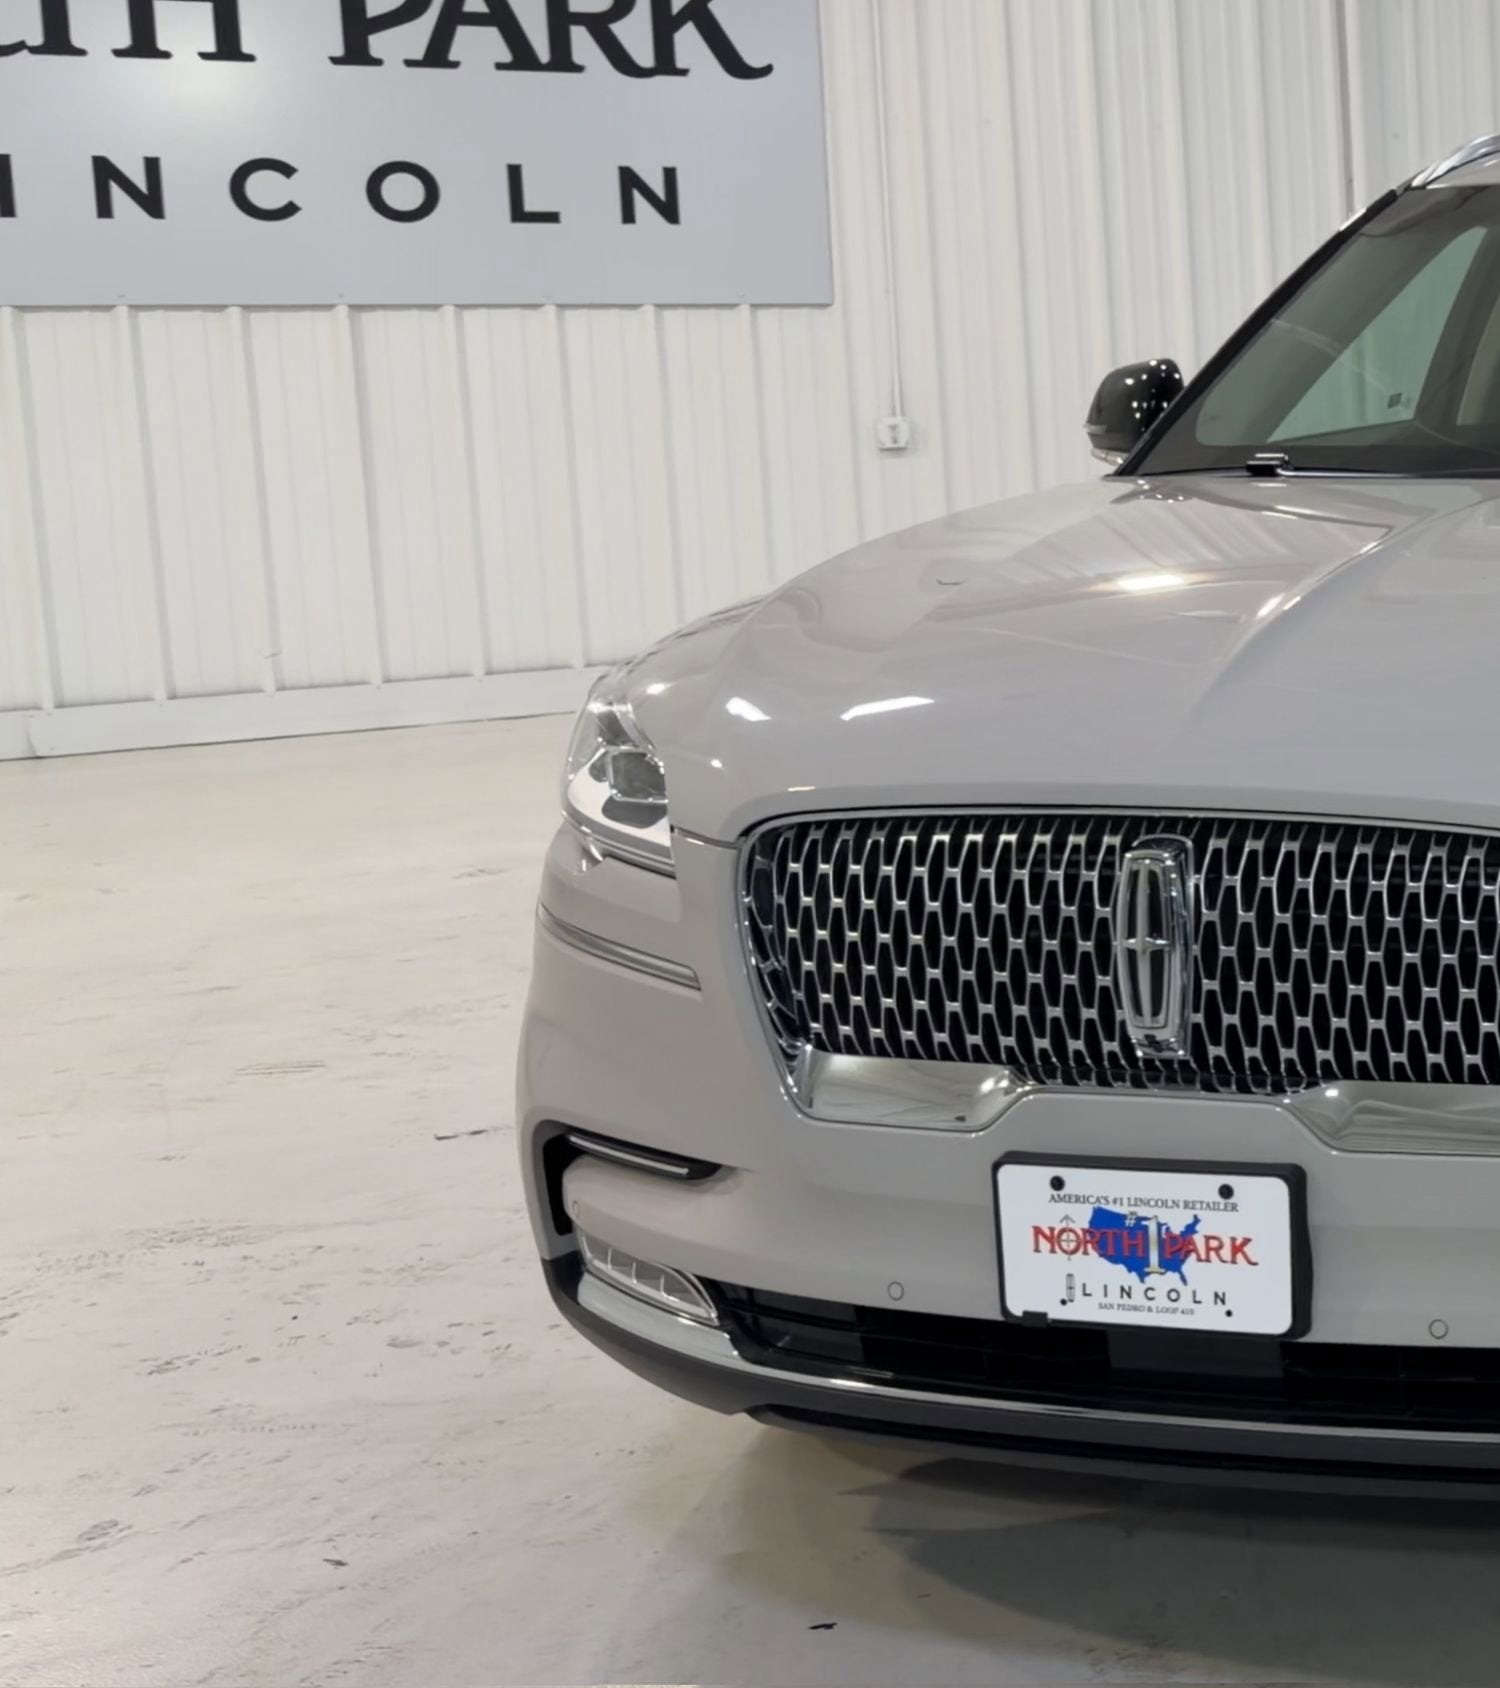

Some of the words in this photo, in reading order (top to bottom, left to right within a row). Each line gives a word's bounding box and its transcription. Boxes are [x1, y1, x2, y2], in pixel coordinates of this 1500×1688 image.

[0, 153, 681, 226] INCOLN
[1049, 1193, 1111, 1206] AMERICA'S
[1112, 1196, 1124, 1207] #1
[1127, 1197, 1181, 1210] LINCOLN
[1183, 1199, 1239, 1213] RETAILER
[1032, 1225, 1146, 1258] NORTH
[1163, 1233, 1259, 1267] PARK
[1082, 1282, 1227, 1306] LINCOLN
